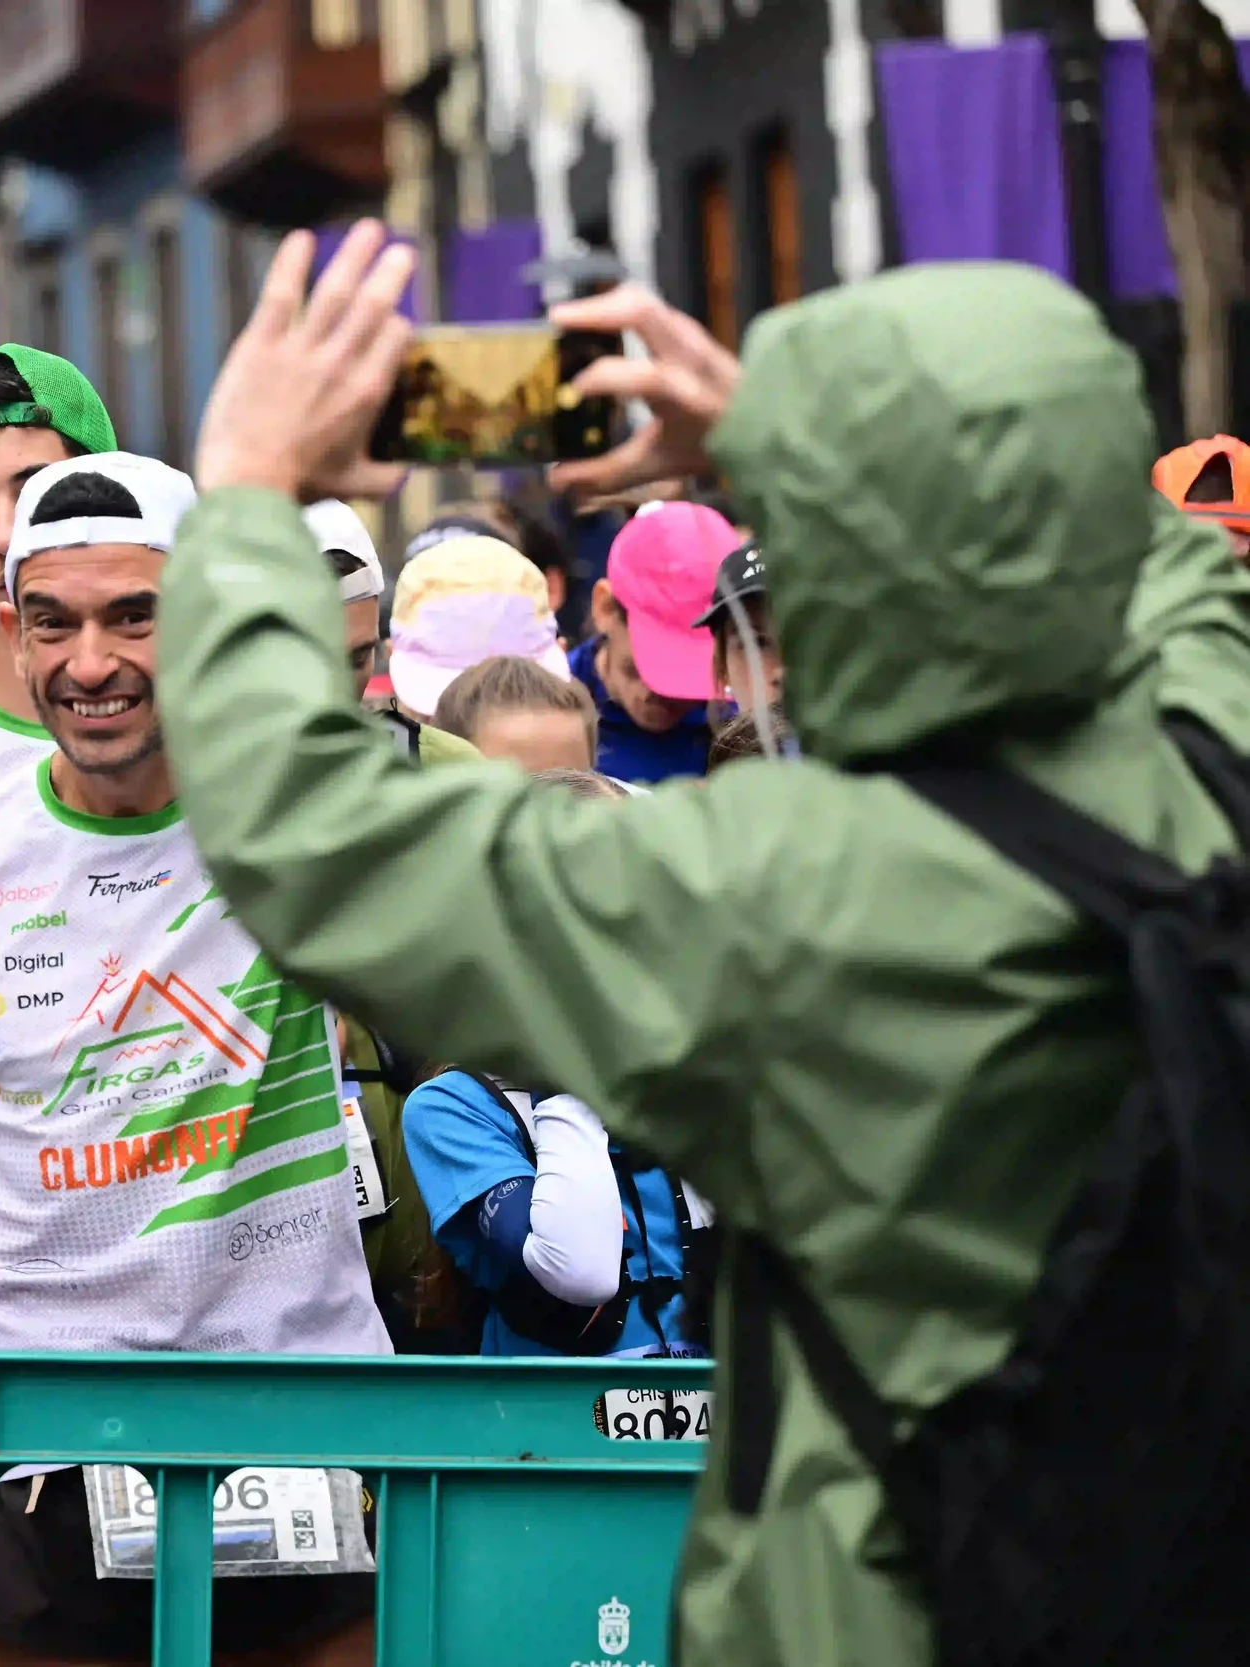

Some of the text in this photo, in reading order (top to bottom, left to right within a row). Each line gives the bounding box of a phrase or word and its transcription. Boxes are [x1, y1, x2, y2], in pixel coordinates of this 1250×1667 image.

[4, 952, 64, 974] Digital
[17, 991, 64, 1010] DMP
[41, 1022, 205, 1117] FIRGAS
[60, 1096, 121, 1116] Gran
[132, 1066, 228, 1101] Canaria
[627, 1389, 697, 1404] CRISINA
